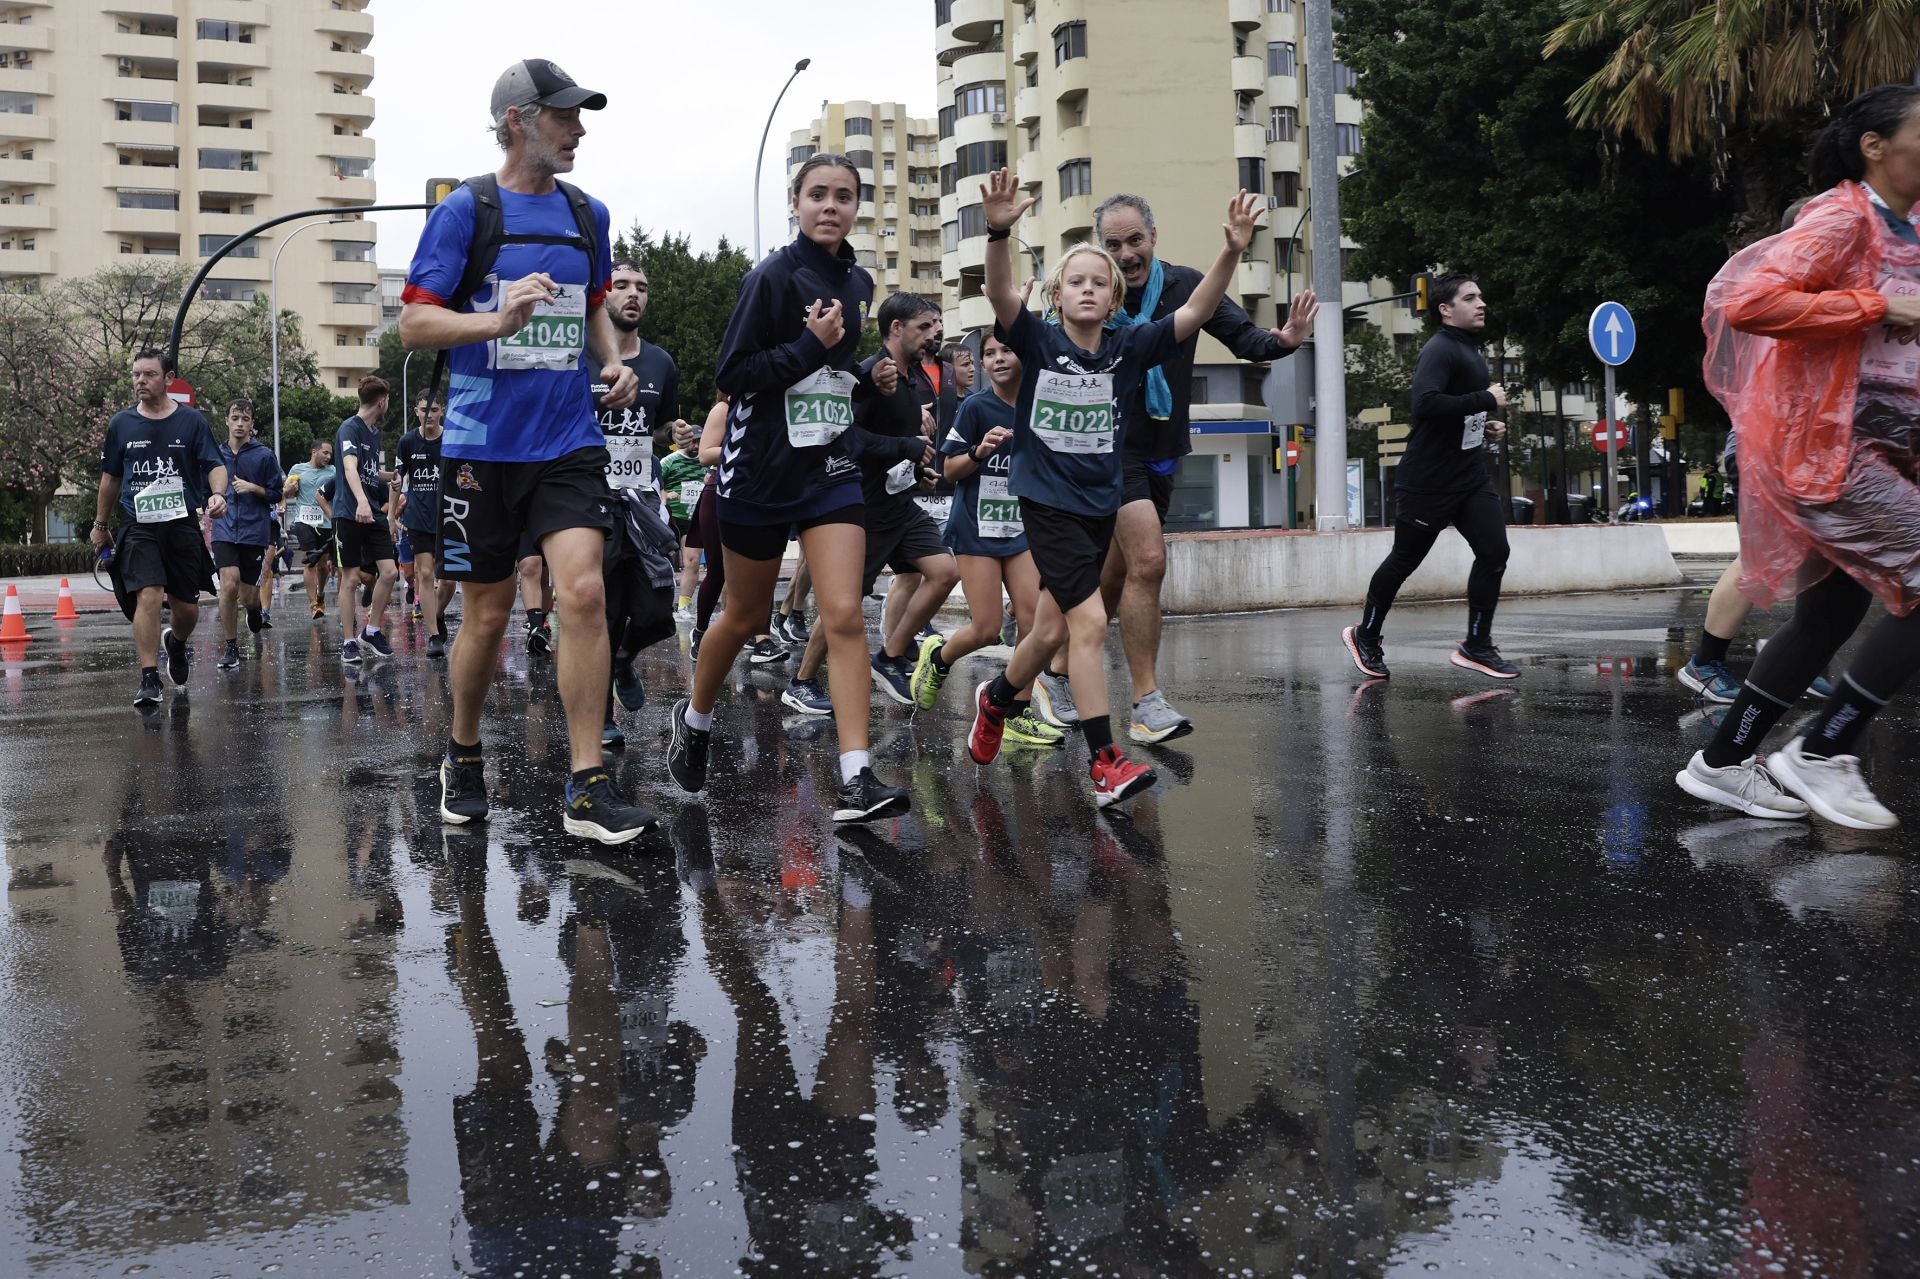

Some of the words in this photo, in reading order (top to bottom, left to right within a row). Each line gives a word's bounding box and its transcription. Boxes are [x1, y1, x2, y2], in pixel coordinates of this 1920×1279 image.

[1038, 406, 1109, 432] 21022
[139, 495, 182, 513] 21765
[1732, 703, 1762, 746] MCKENZIE
